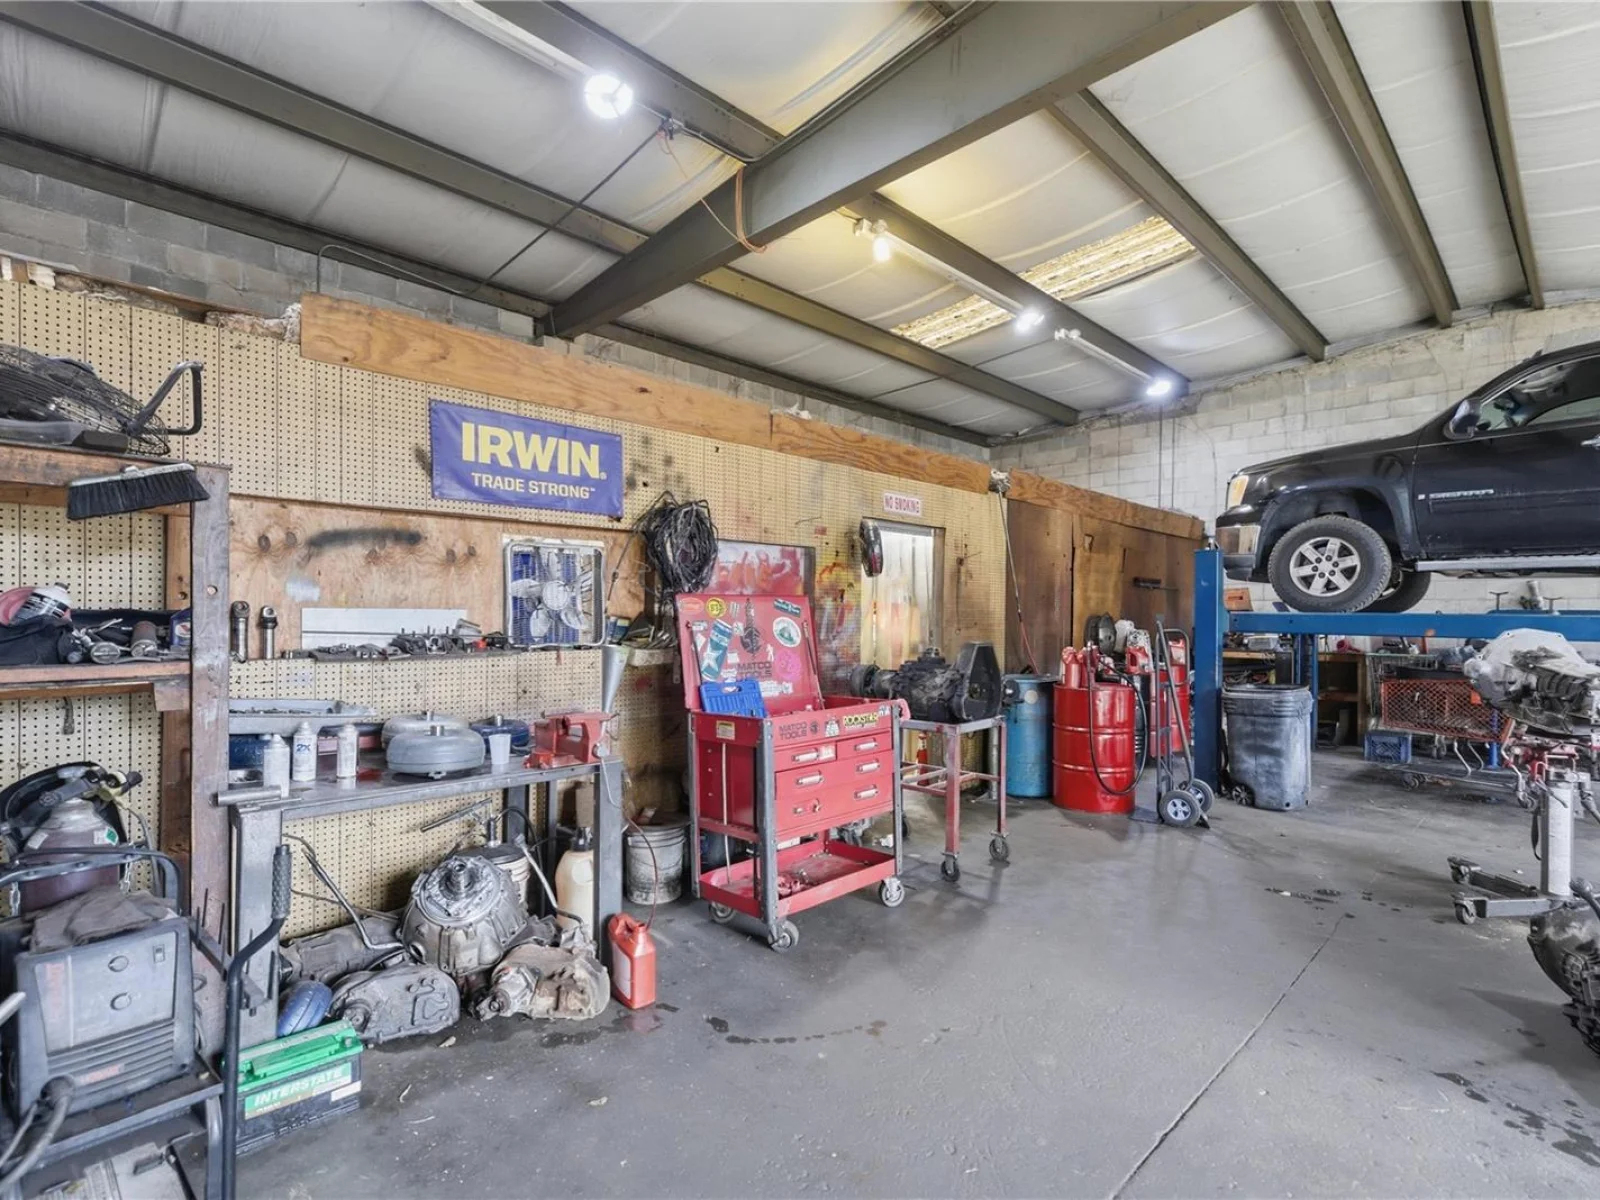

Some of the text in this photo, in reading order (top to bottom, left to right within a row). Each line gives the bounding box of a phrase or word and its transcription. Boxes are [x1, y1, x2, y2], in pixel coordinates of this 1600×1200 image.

[461, 422, 600, 480] IRWIN
[472, 472, 590, 500] TRADE STRONG
[885, 494, 920, 513] NO SMOKING
[737, 661, 772, 671] MATCO
[779, 721, 807, 733] MATCO
[779, 728, 807, 740] TOOLS
[255, 1068, 342, 1103] INTERSTATE
